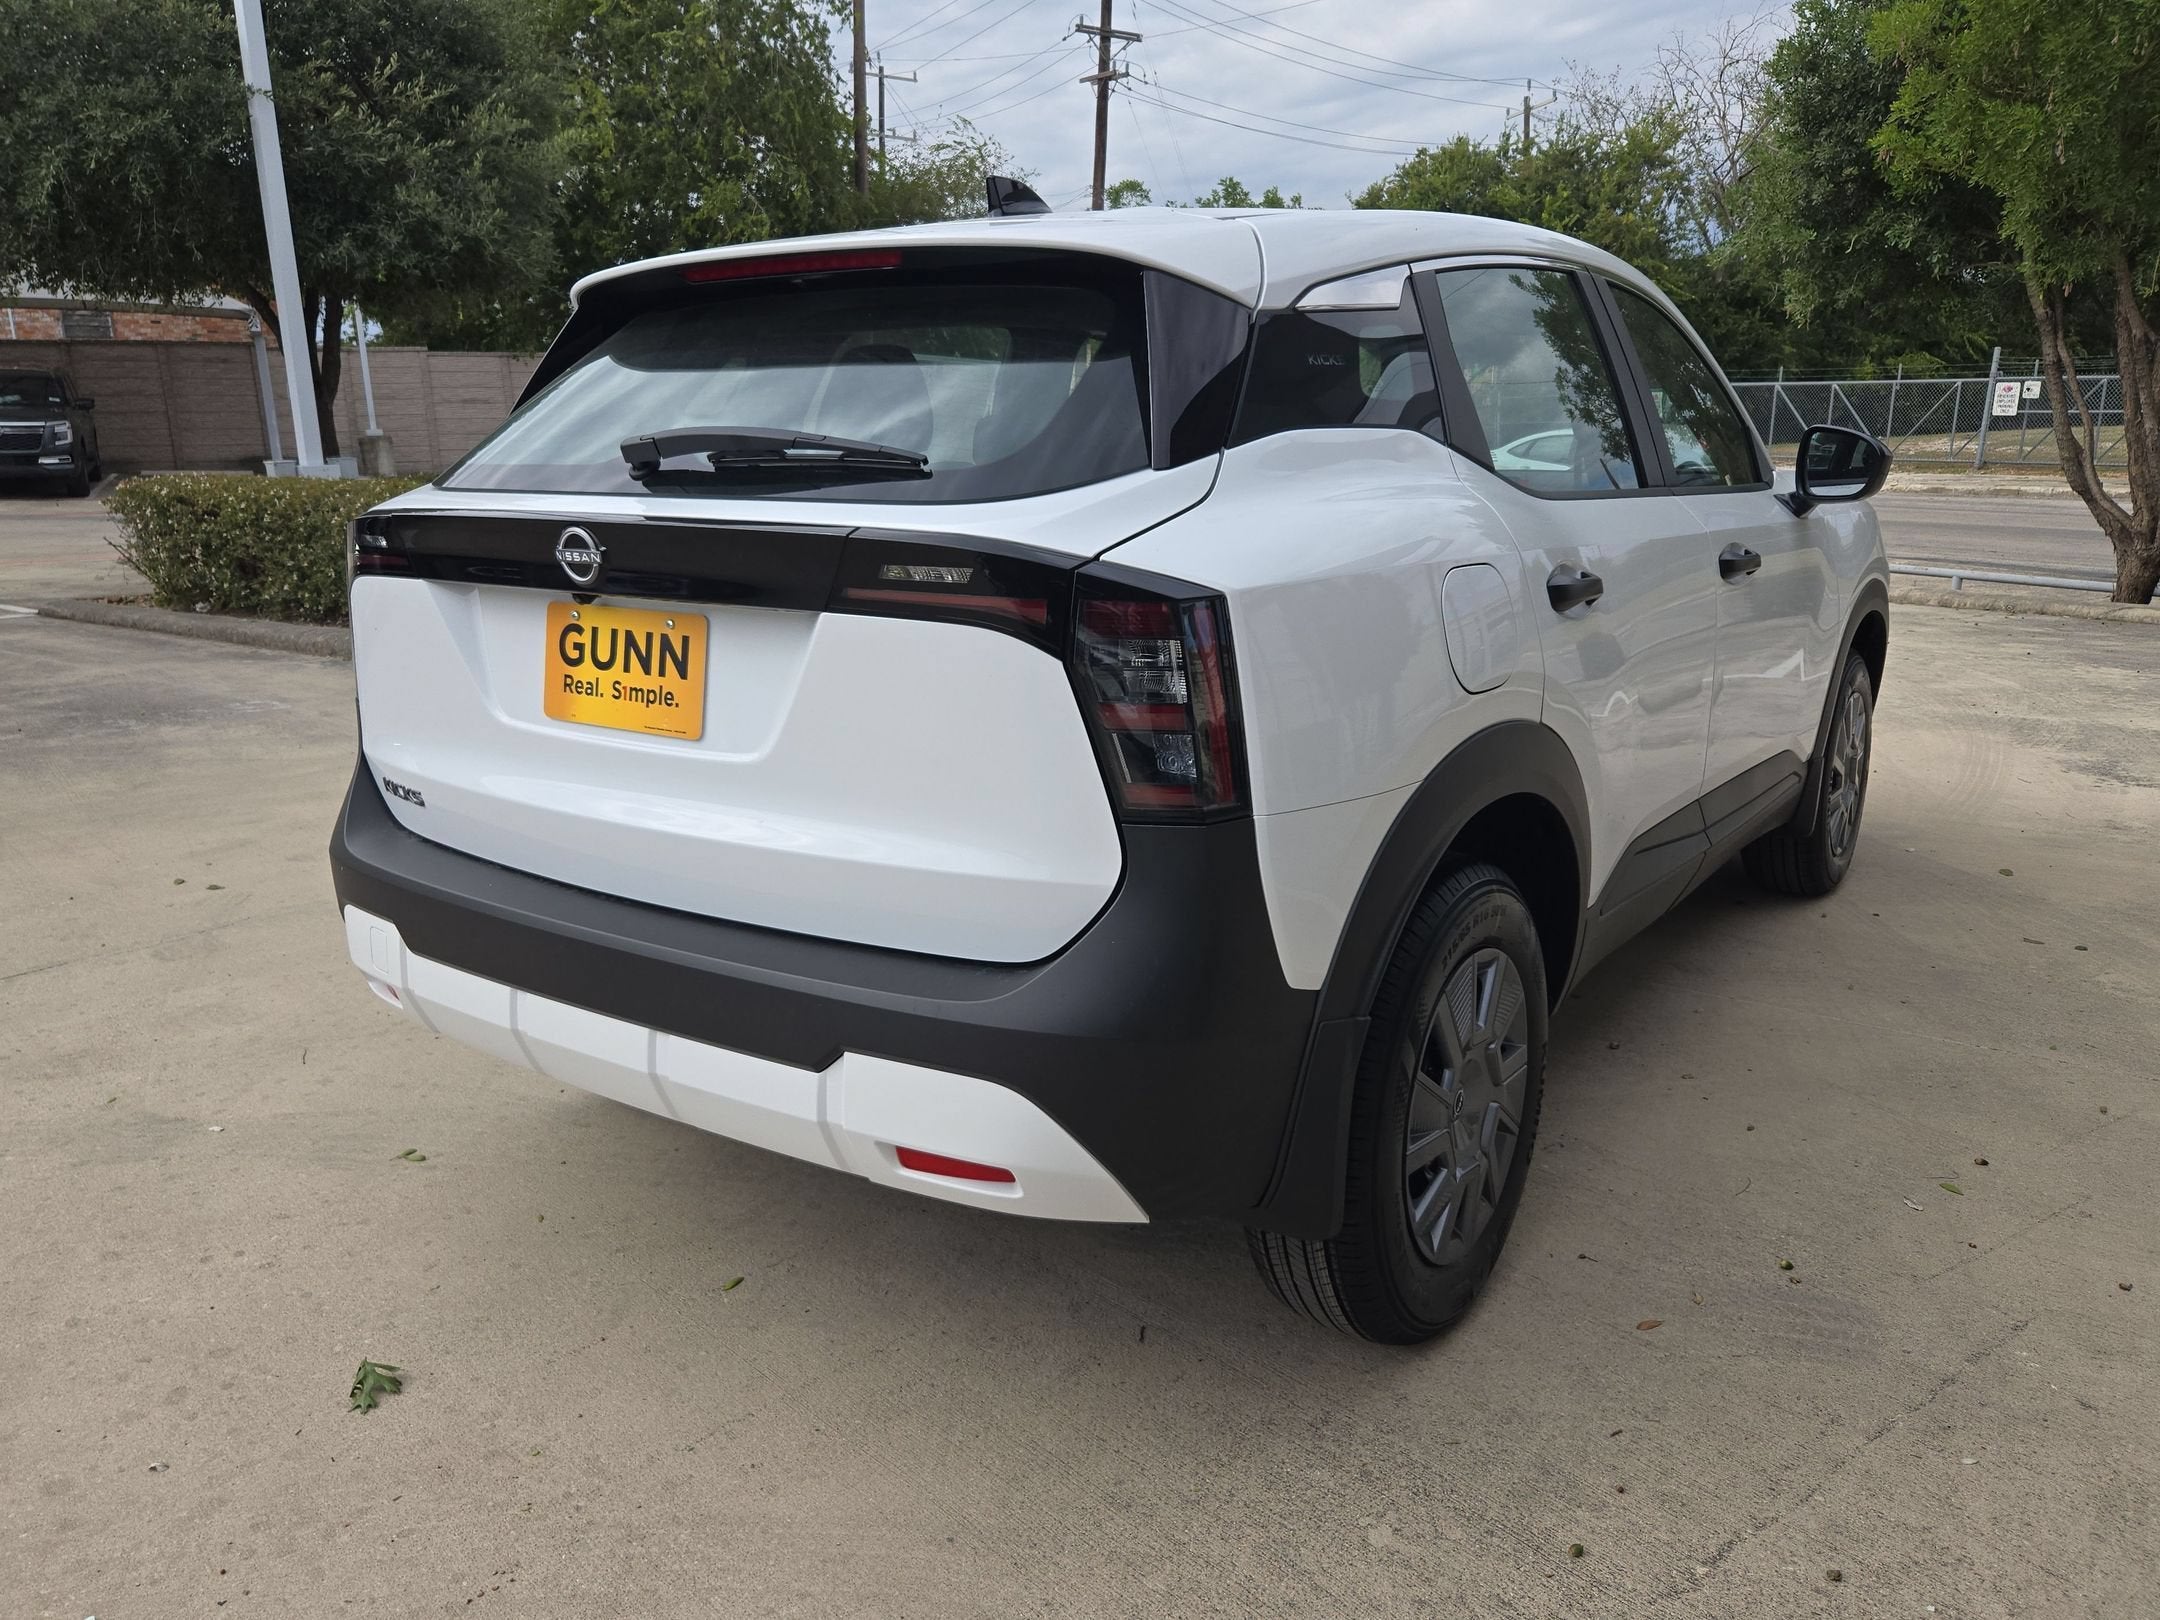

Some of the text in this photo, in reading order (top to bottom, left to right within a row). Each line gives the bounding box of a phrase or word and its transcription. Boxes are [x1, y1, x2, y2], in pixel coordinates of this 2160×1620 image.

[556, 549, 601, 563] NISSAN
[559, 622, 690, 680] GUNN
[563, 674, 604, 698] Real.
[382, 776, 426, 807] KICKS
